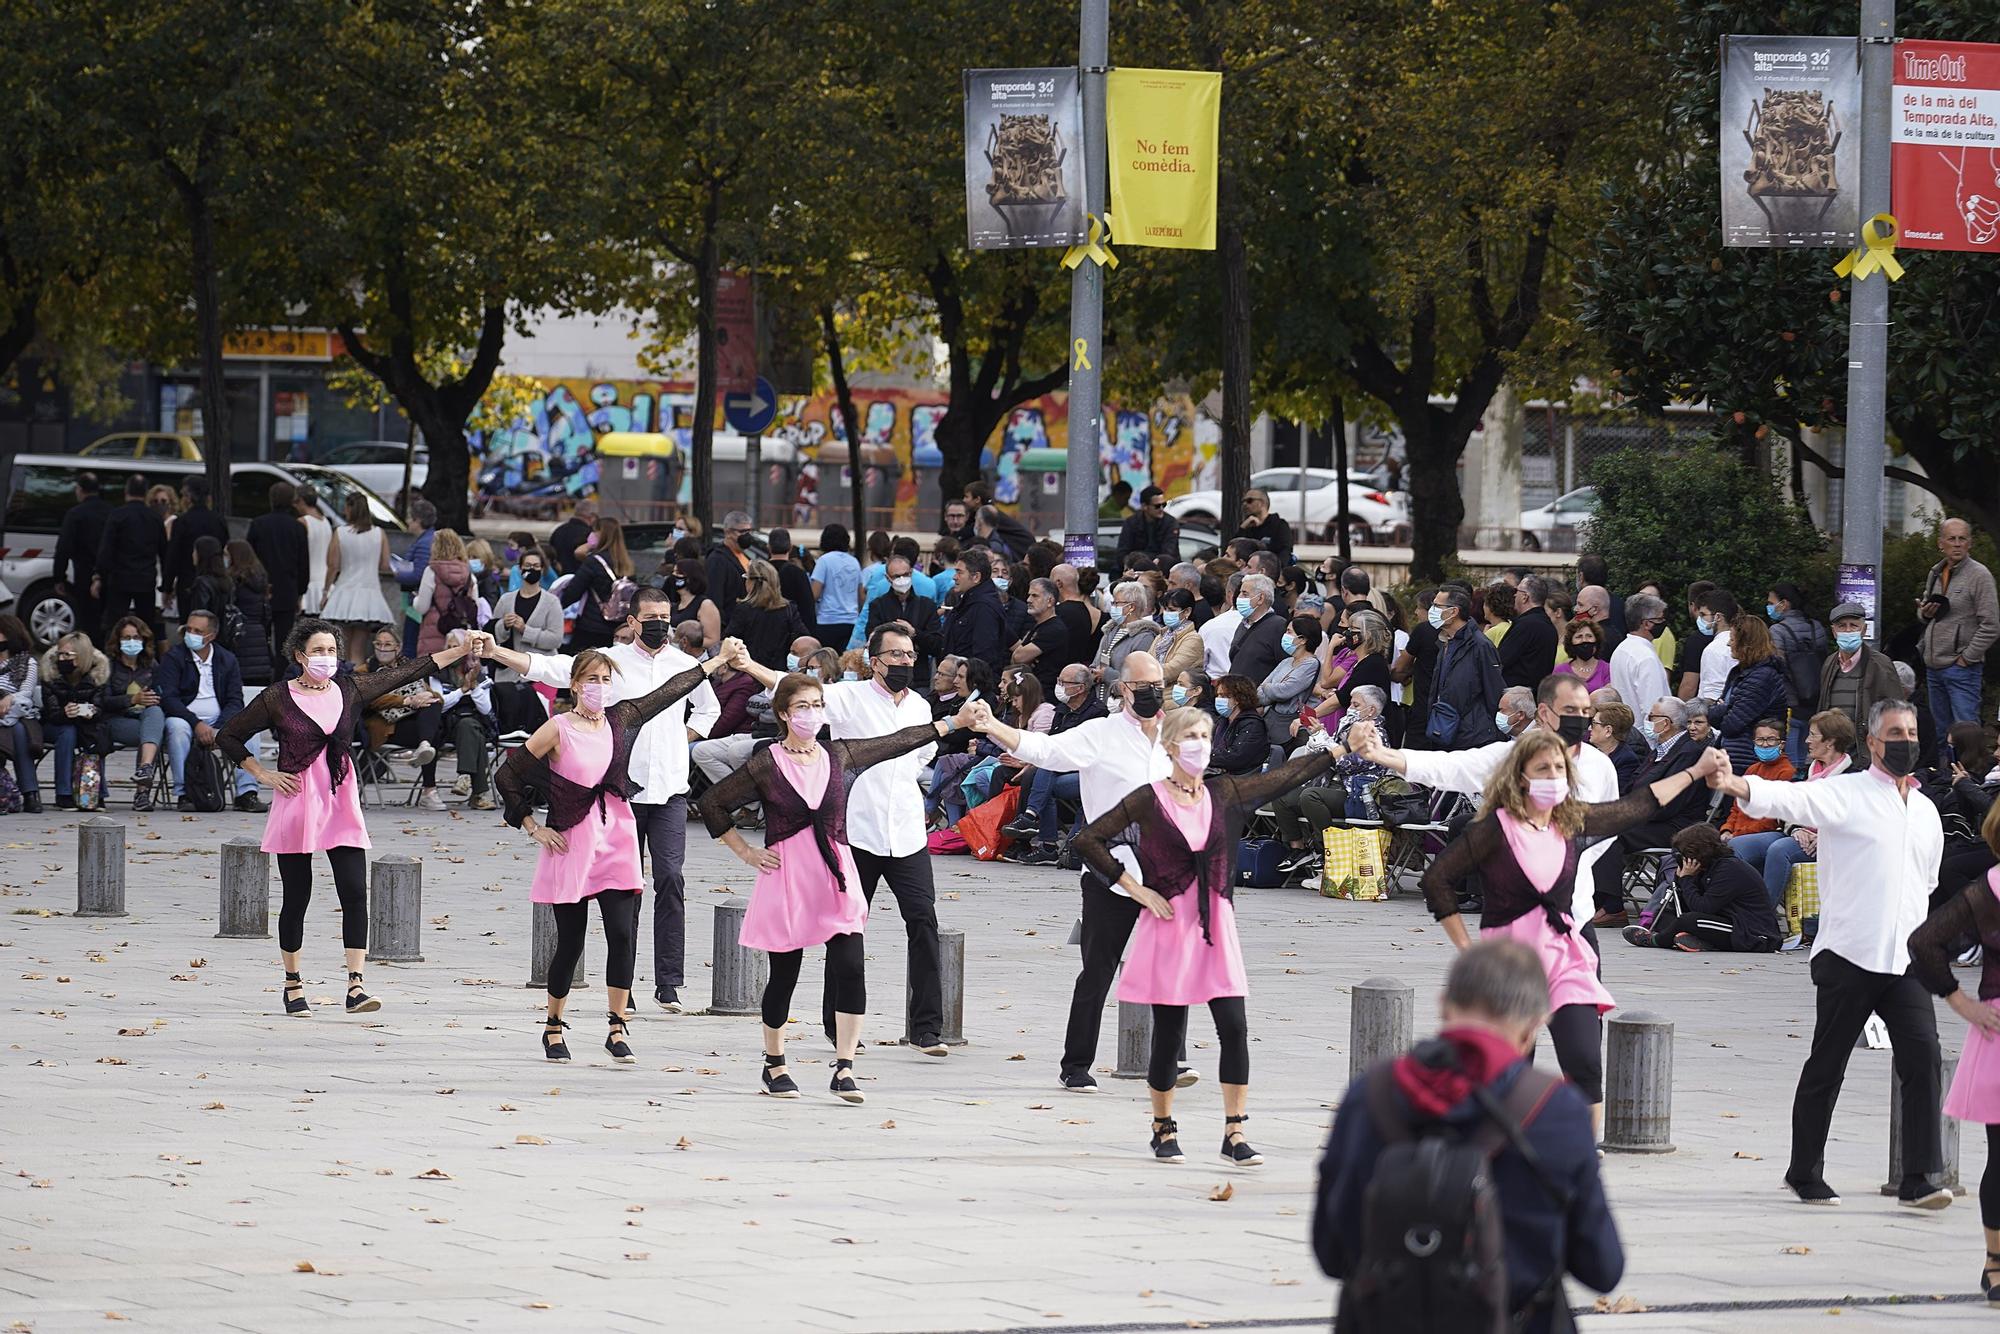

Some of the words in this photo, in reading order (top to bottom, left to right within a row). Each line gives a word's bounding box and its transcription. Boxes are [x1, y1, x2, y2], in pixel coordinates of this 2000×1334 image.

[1754, 51, 1807, 64] temporada
[1810, 48, 1831, 66] 30
[1754, 61, 1773, 71] alta
[991, 81, 1036, 93] temporada
[1038, 78, 1055, 93] 30
[991, 91, 1007, 100] alta
[1903, 93, 1917, 106] de
[1921, 94, 1932, 107] la
[1936, 94, 1955, 108] mà
[1959, 96, 1977, 109] del
[1903, 109, 1967, 127] Temporada
[1969, 113, 1998, 128] Alta,
[1903, 128, 1914, 136] de
[1915, 128, 1923, 137] la
[1926, 128, 1938, 138] mà
[1941, 130, 1952, 139] de
[1954, 130, 1962, 139] la
[1965, 131, 1995, 141] cultura
[1136, 139, 1157, 154] No
[1162, 140, 1189, 155] fem
[1132, 158, 1196, 173] comèdia.
[1904, 229, 1944, 240] timeout.cat
